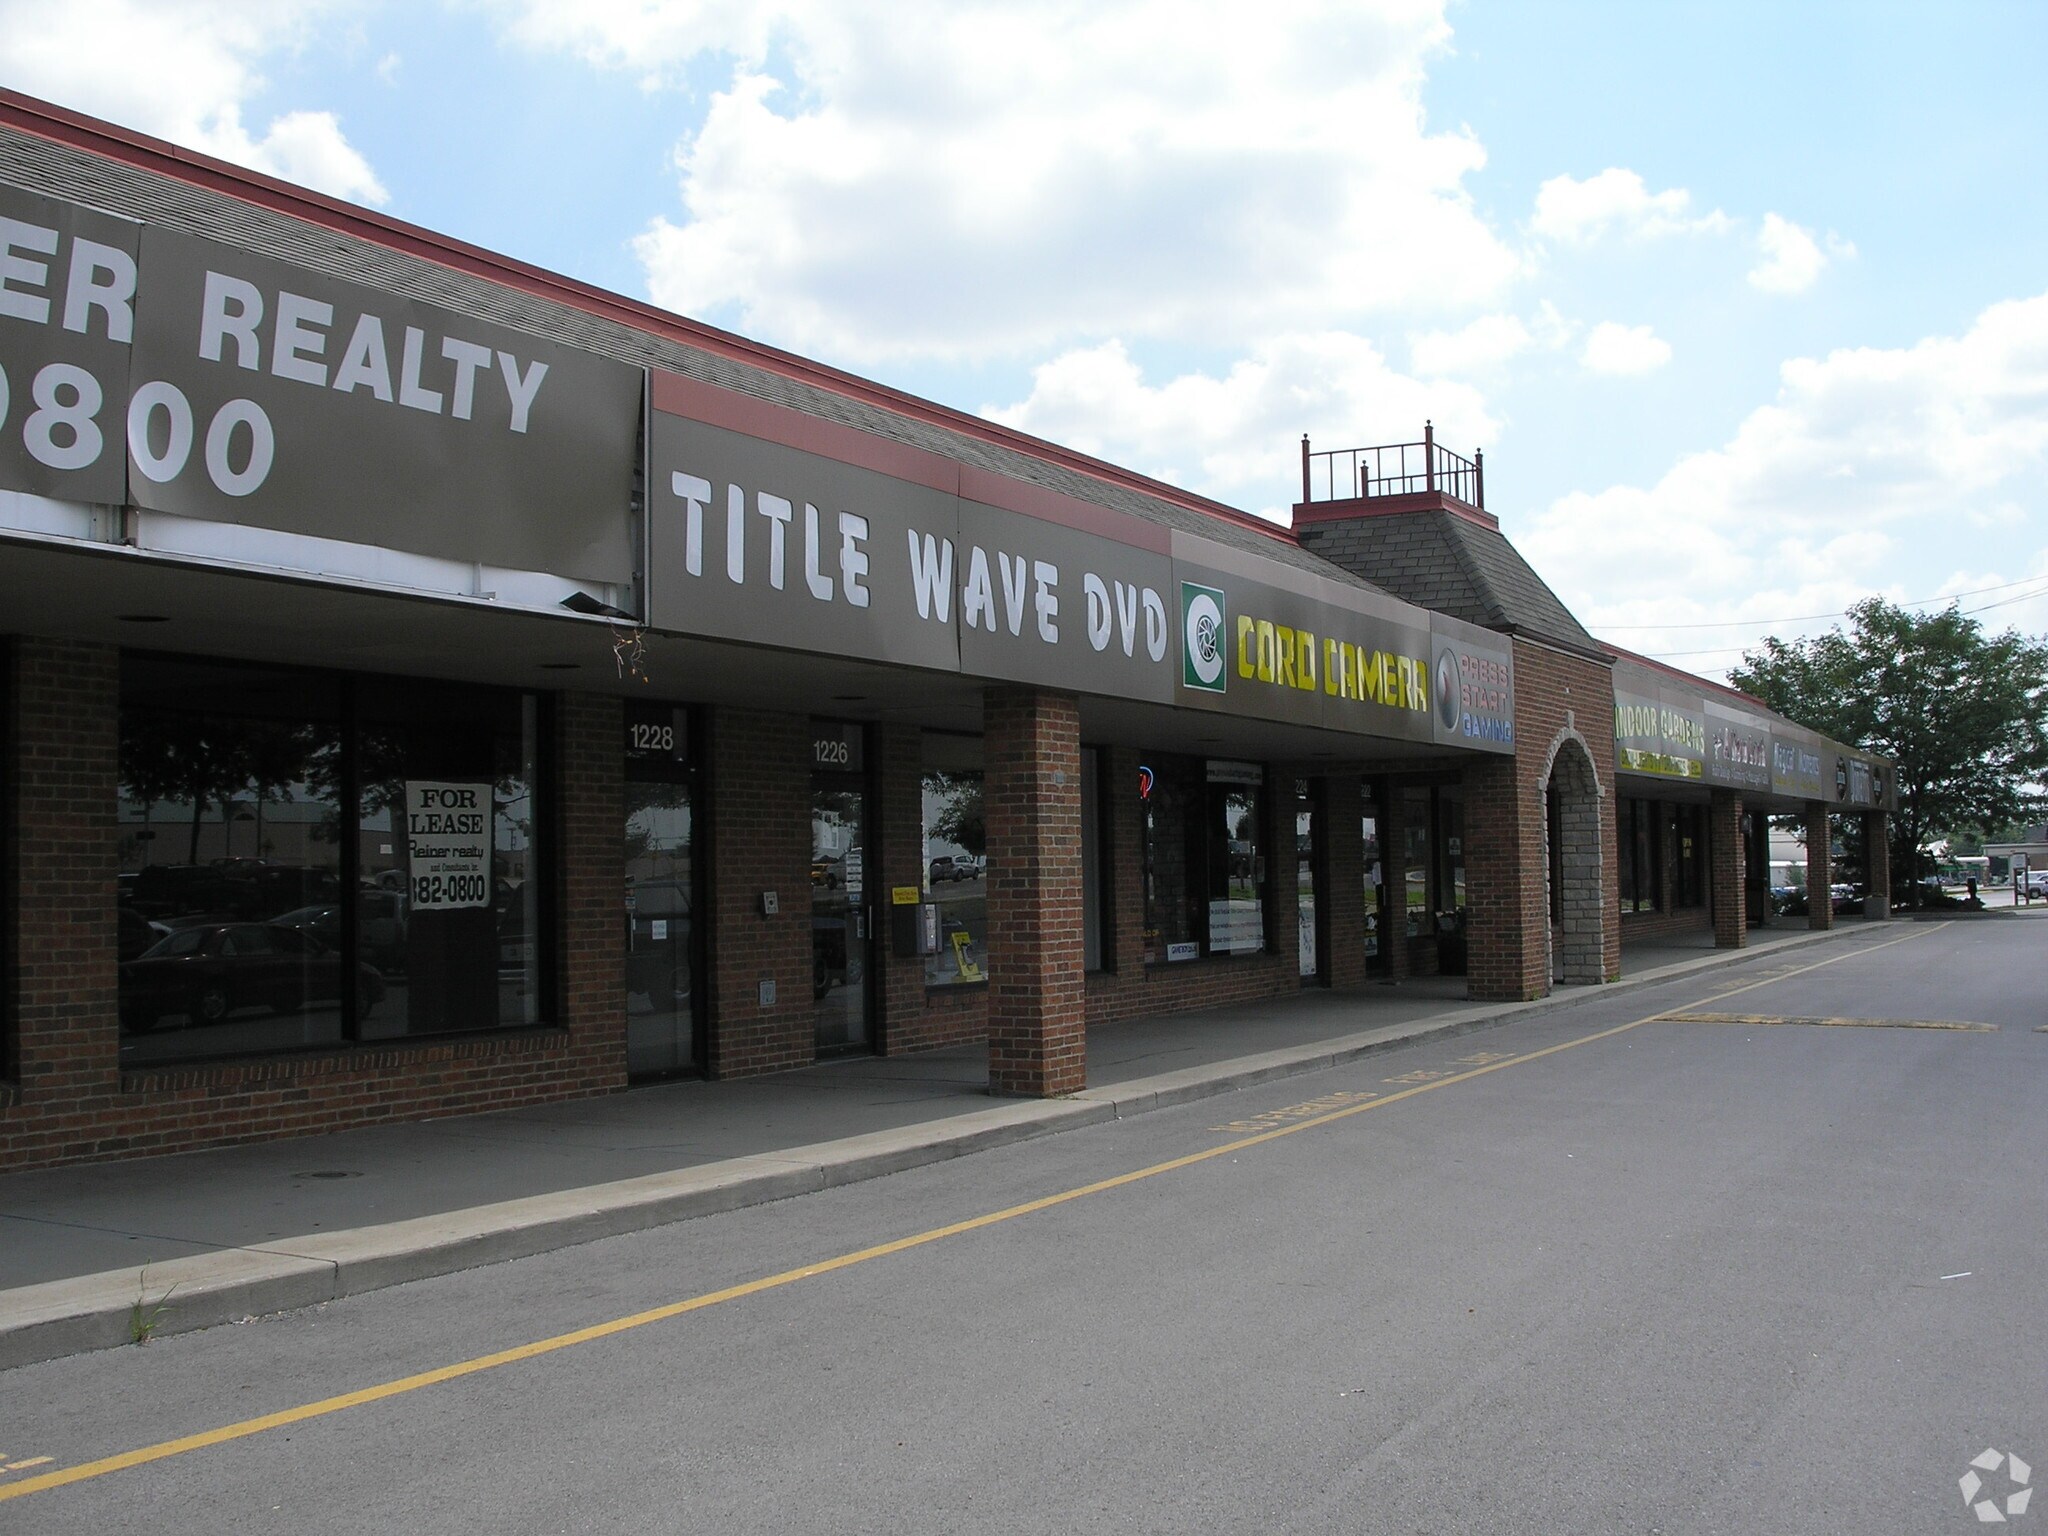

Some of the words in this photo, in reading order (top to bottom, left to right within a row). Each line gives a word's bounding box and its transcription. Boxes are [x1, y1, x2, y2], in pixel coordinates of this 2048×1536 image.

[0, 216, 138, 344] ER
[199, 270, 549, 434] REALTY
[0, 361, 274, 497] 800
[672, 470, 870, 608] TITLE
[907, 529, 1059, 644] WAVE
[1084, 572, 1168, 662] DVD
[1237, 614, 1316, 691] CORD
[1323, 637, 1429, 713] CAMERA
[1461, 654, 1508, 687] PRESS
[1461, 683, 1508, 713] START
[630, 724, 674, 750] 1228
[1463, 712, 1513, 743] GAMING
[1615, 706, 1657, 738] INDOOR
[1661, 709, 1705, 754] GARDENS
[813, 740, 848, 764] 1226
[420, 789, 478, 808] FOR
[409, 814, 484, 835] LEASE
[409, 839, 450, 858] Reiner
[452, 845, 484, 861] realty
